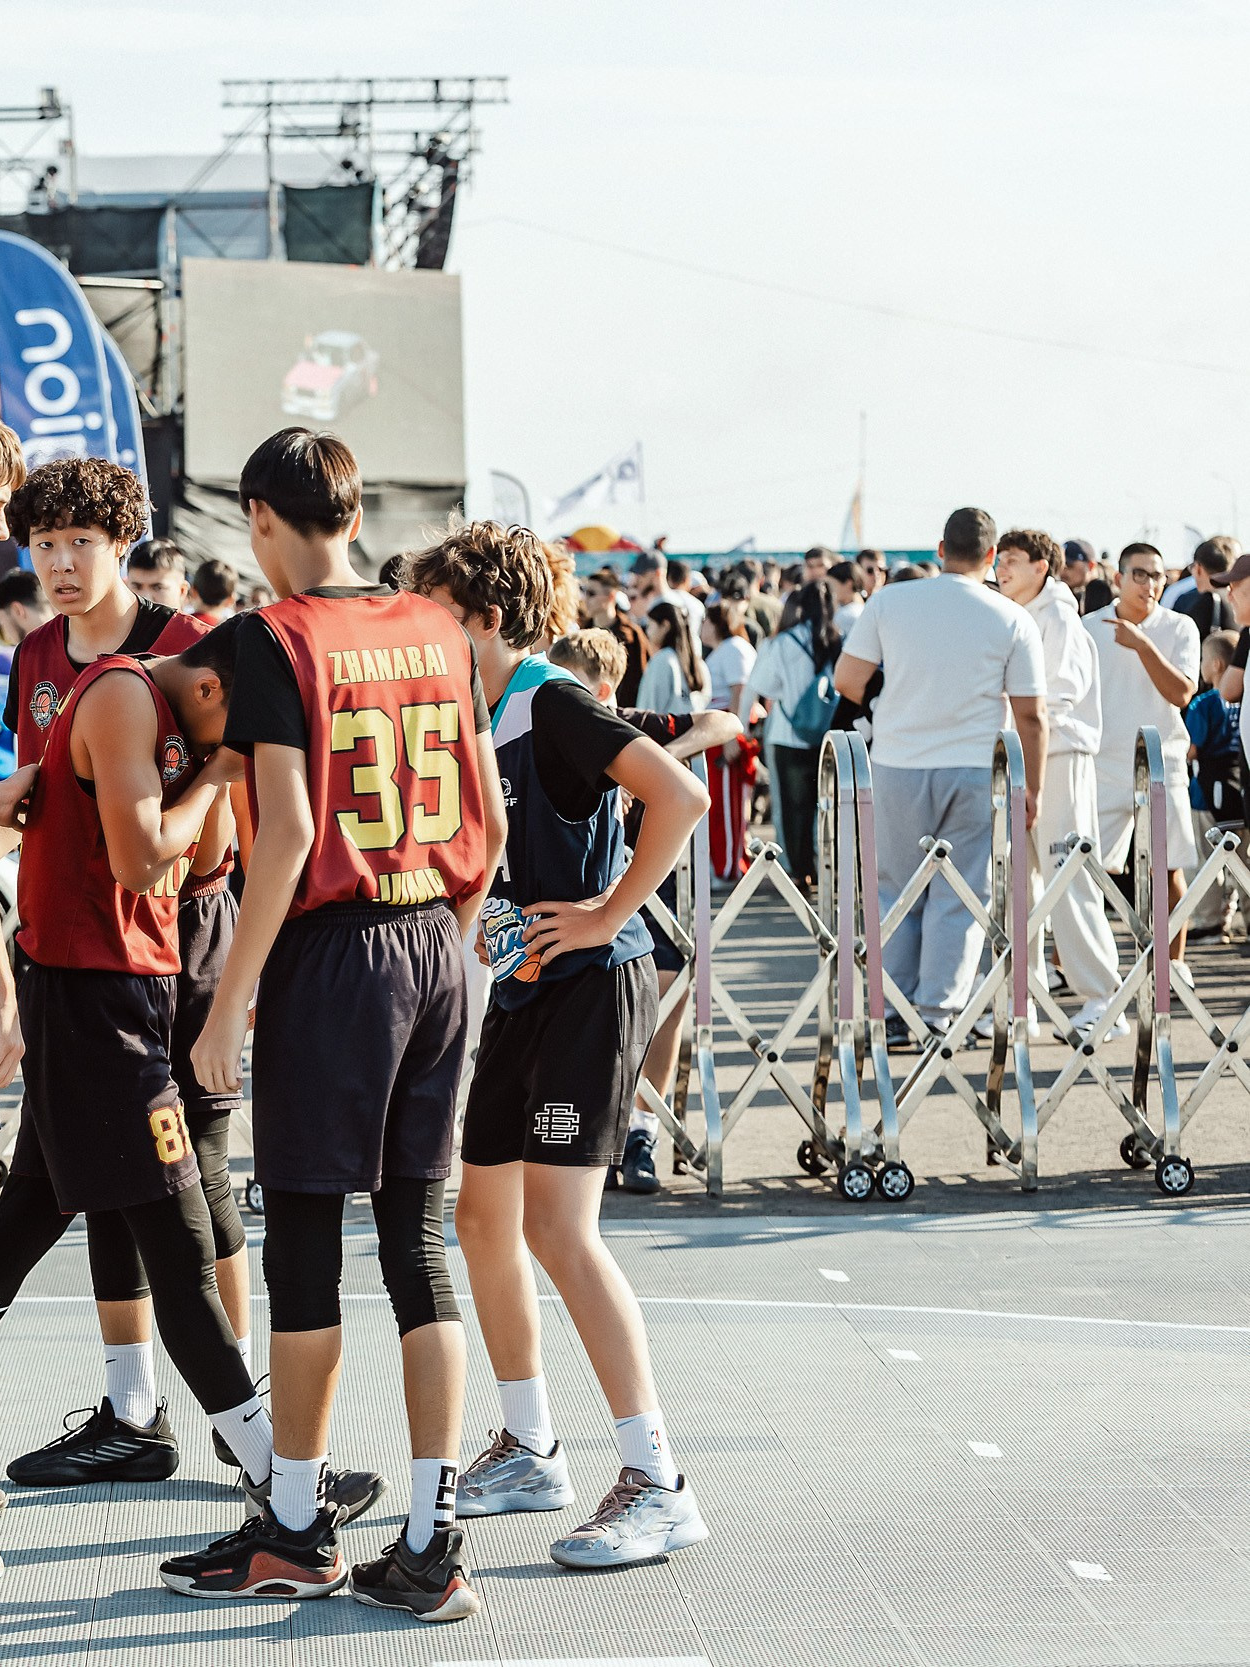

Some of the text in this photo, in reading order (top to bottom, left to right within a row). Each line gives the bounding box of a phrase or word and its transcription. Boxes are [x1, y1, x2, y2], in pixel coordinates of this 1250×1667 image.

[327, 643, 449, 686] ZHANABAI
[330, 700, 463, 853] 35
[371, 868, 447, 906] JUMP
